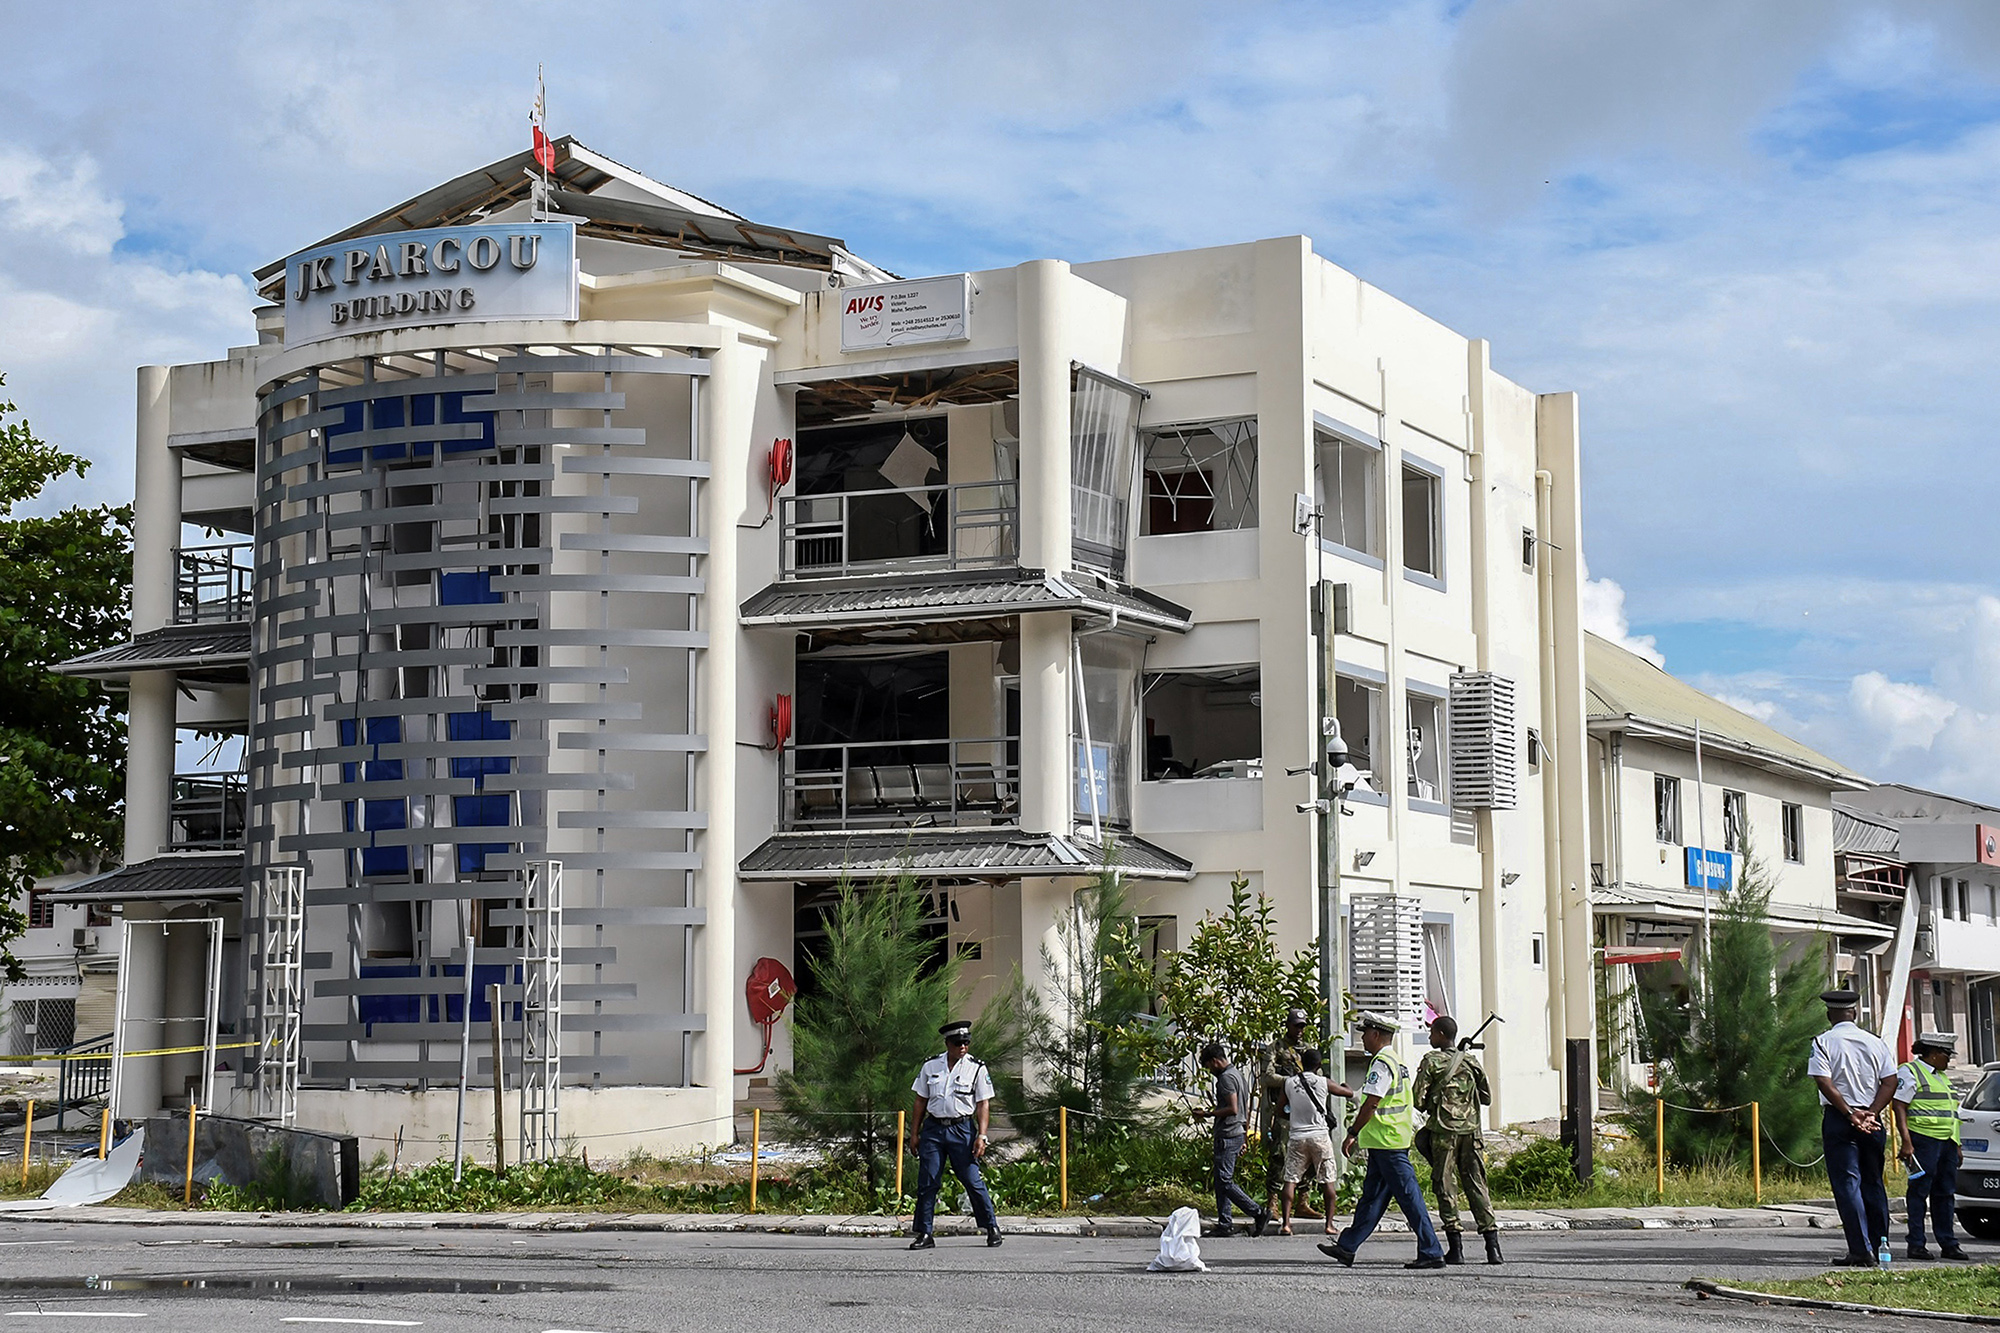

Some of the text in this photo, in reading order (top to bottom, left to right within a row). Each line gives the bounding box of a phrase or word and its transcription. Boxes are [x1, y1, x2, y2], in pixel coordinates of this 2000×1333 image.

[294, 234, 542, 301] JK PARCOU
[330, 287, 476, 324] BUILDING
[845, 295, 885, 315] AVIS
[1983, 1177, 2000, 1189] GS3
